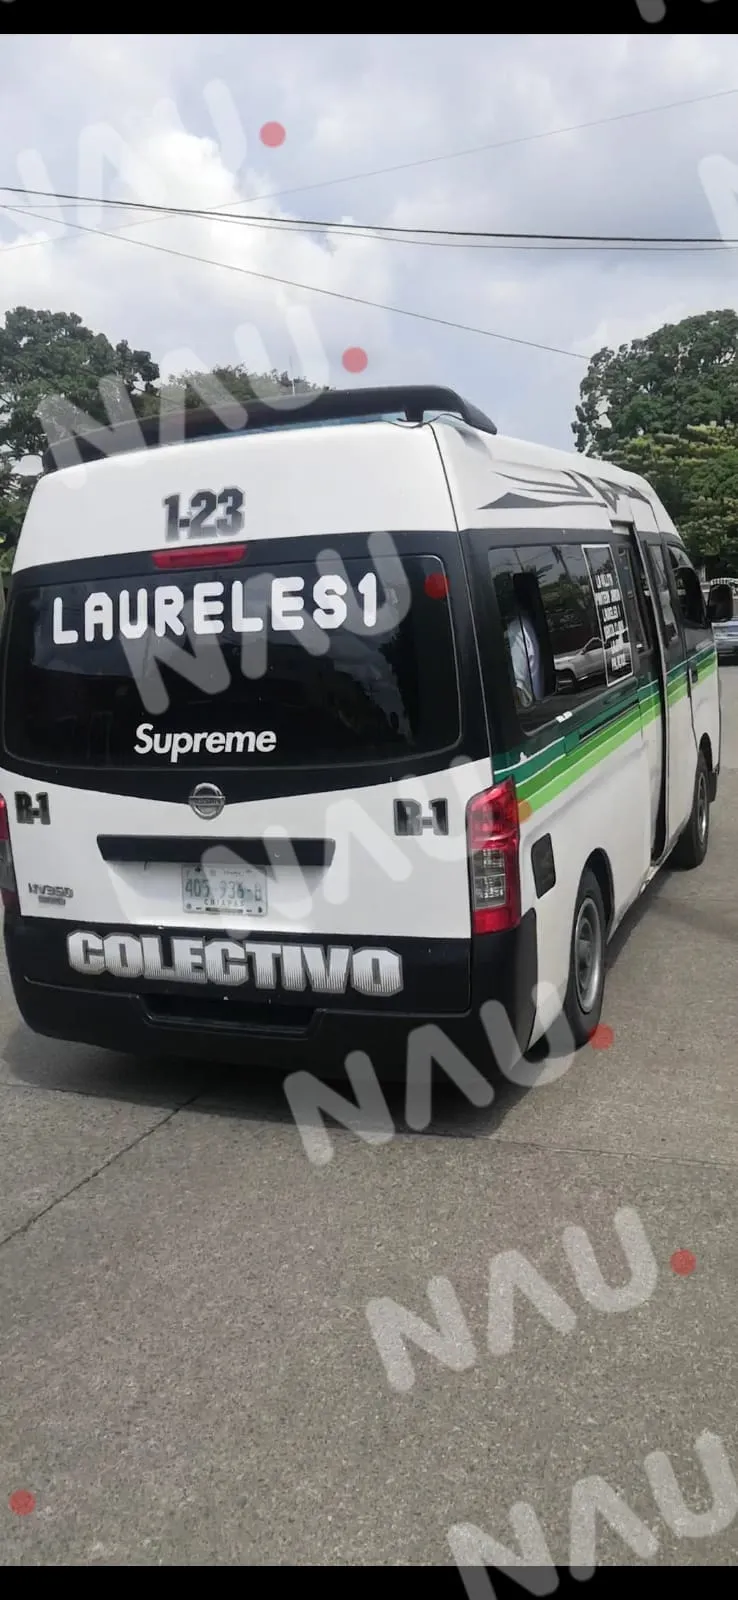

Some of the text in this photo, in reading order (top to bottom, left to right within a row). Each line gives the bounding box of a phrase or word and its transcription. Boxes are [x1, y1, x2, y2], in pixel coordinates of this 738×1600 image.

[162, 486, 246, 542] 1-23
[134, 723, 277, 762] Supreme
[14, 791, 51, 825] R-1
[393, 798, 449, 836] R-1
[66, 929, 404, 997] COLECTIVO
